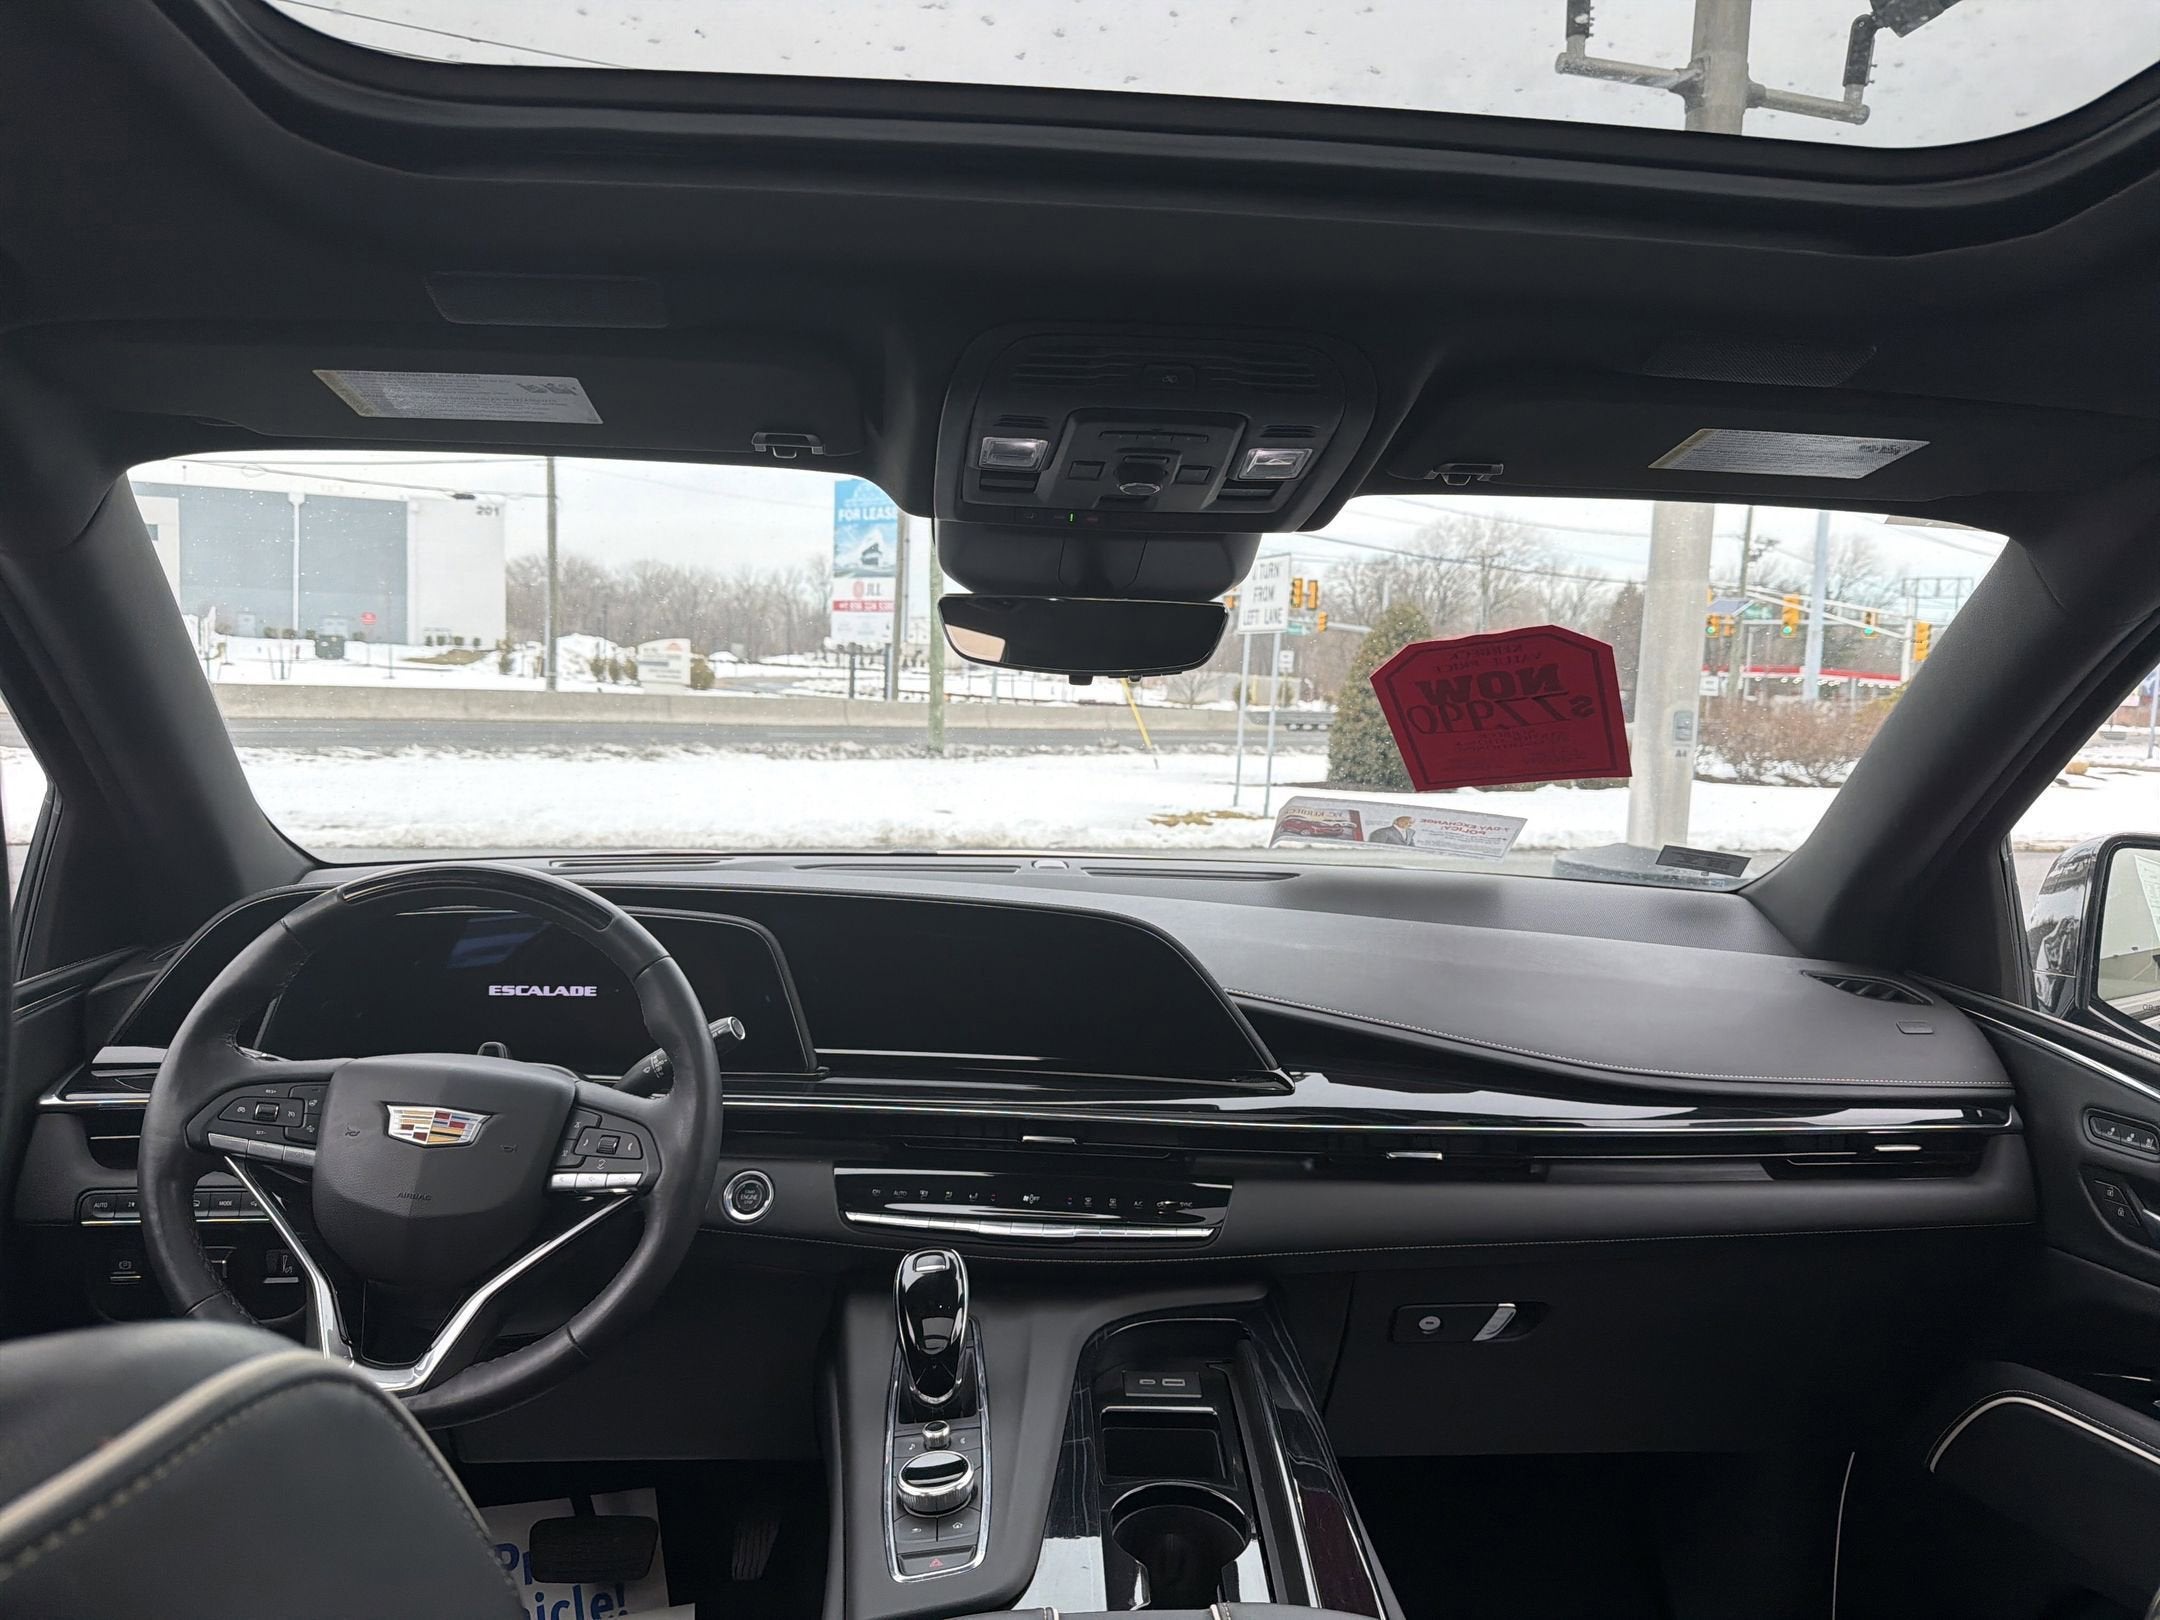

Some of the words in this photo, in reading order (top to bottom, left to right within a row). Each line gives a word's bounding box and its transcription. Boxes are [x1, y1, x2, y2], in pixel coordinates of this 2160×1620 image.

[838, 507, 861, 522] FOR
[1253, 585, 1275, 603] FROM
[1243, 609, 1260, 626] LEFT
[1264, 608, 1283, 625] LANE
[488, 985, 598, 997] ESCALADE
[93, 1201, 108, 1209] AUTO
